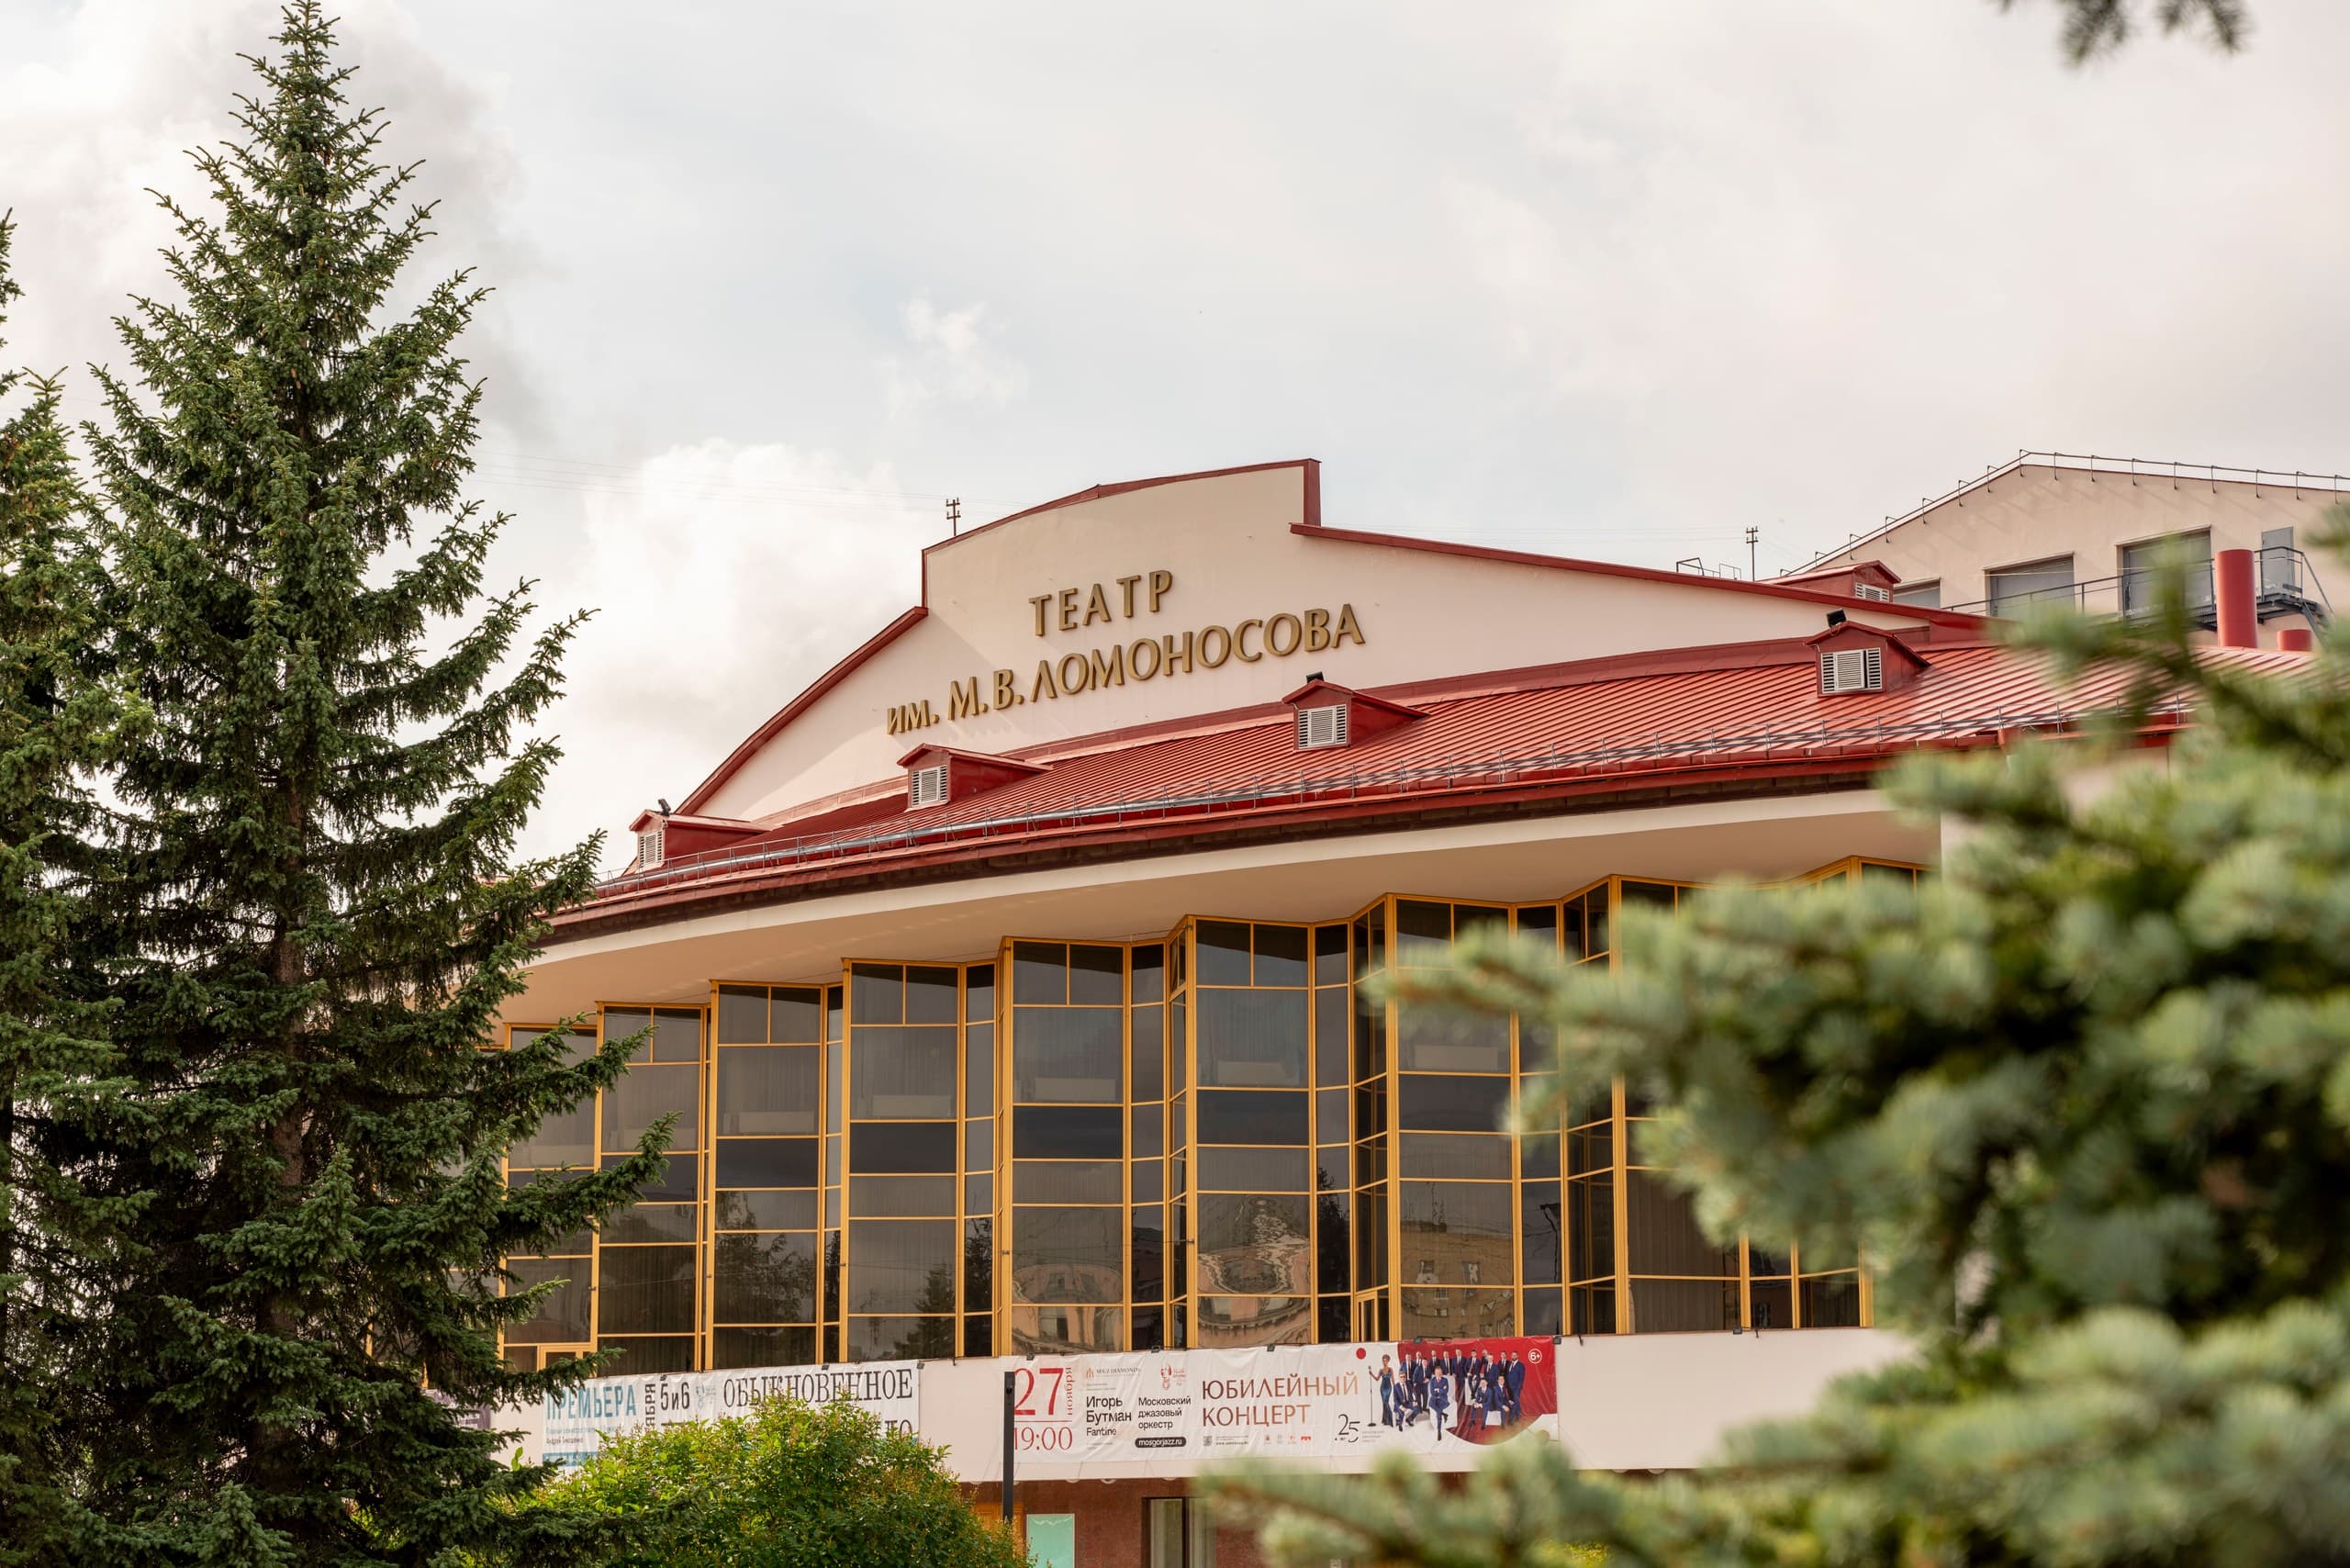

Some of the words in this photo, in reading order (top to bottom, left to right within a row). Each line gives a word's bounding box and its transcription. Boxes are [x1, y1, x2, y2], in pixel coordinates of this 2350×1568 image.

[1028, 569, 1173, 637] ТЕАТР
[1029, 602, 1366, 703] ЛОМОНОСОВА
[723, 1369, 912, 1407] ОБЫКНОВЕННОЕ
[1013, 1368, 1064, 1416] 27
[1202, 1372, 1359, 1400] ЮБИЛЕЙНЫЙ
[547, 1384, 636, 1420] ПРЕМЬЕРА
[645, 1383, 656, 1428] ЯБРЯ
[1086, 1396, 1123, 1410] Игорь
[1138, 1395, 1192, 1406] Московский
[1138, 1407, 1182, 1418] джазовый
[1086, 1410, 1132, 1426] Бутман
[1138, 1421, 1173, 1430] оркестр
[1202, 1404, 1311, 1427] КОНЦЕРТ
[1013, 1426, 1072, 1450] 19:00
[1086, 1427, 1116, 1436] Fantine
[1337, 1414, 1360, 1443] 25
[1138, 1438, 1182, 1447] mosgorjazz.ru
